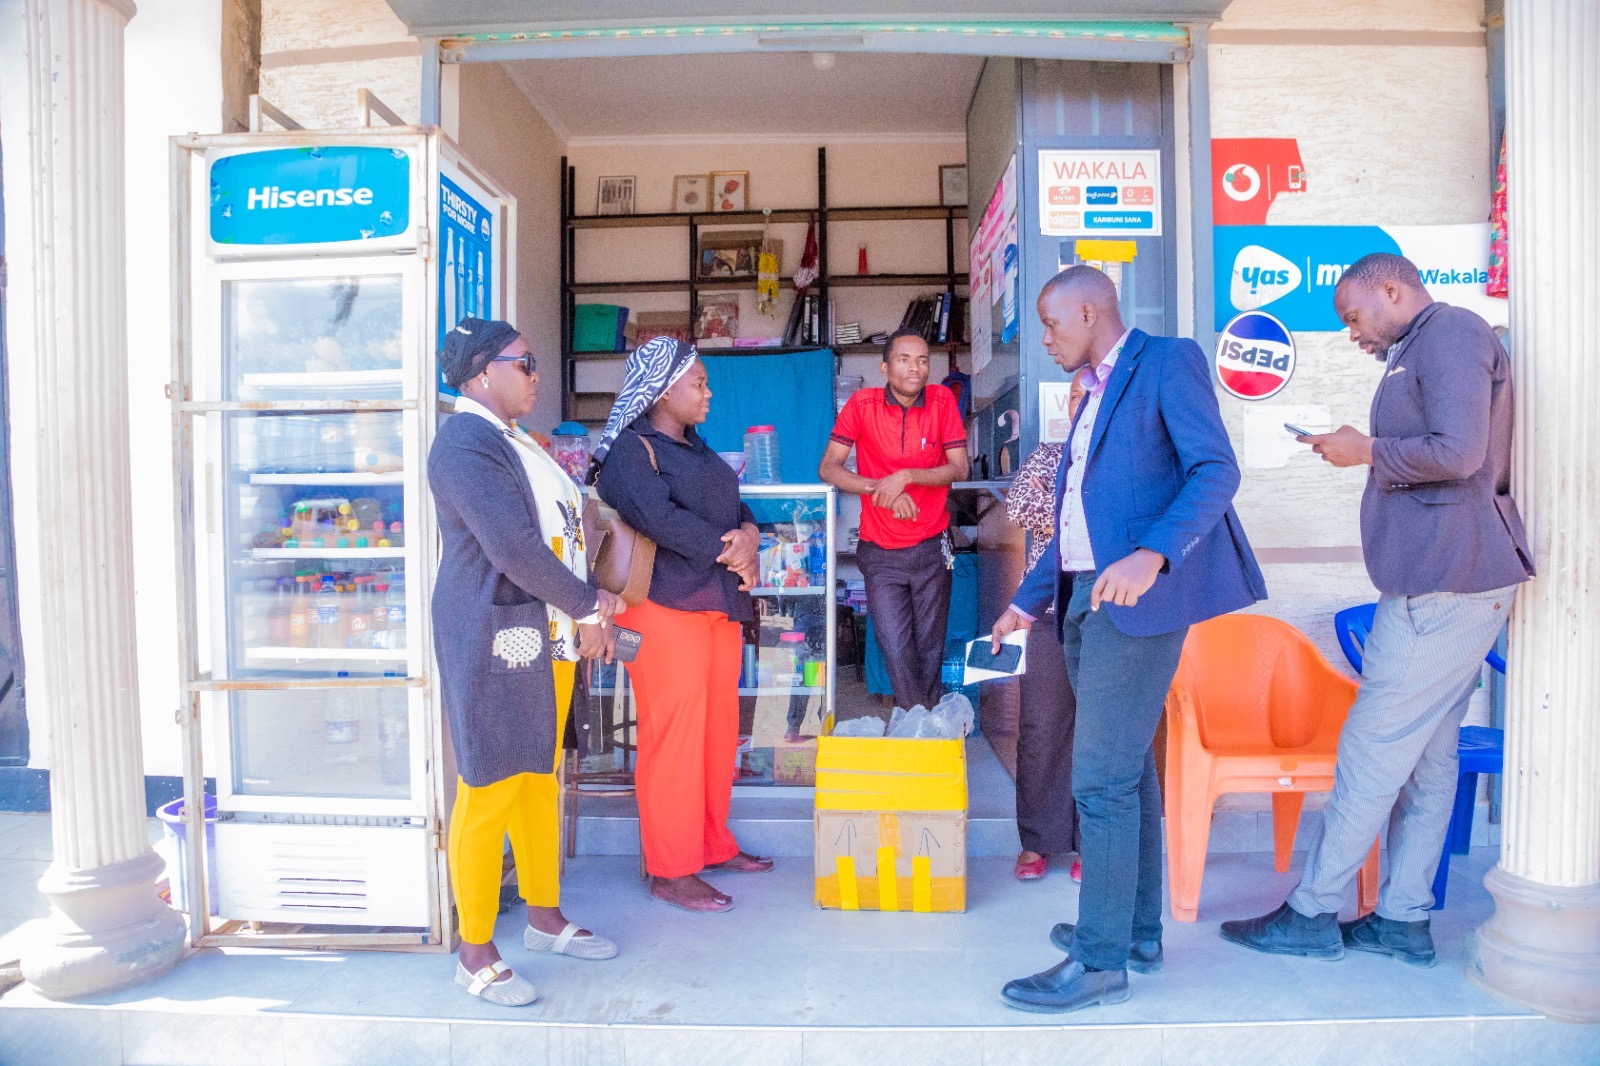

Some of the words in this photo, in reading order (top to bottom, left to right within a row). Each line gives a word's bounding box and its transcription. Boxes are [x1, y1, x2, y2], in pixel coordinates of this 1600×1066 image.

[1053, 161, 1147, 180] WAKALA
[247, 187, 373, 210] Hisense
[441, 184, 477, 224] THIRSTY
[1053, 193, 1075, 201] airtel
[443, 203, 457, 221] FOR
[457, 214, 475, 234] MORE
[1242, 267, 1290, 294] yas
[1418, 268, 1489, 285] Wakala
[1220, 339, 1290, 372] PEPSI
